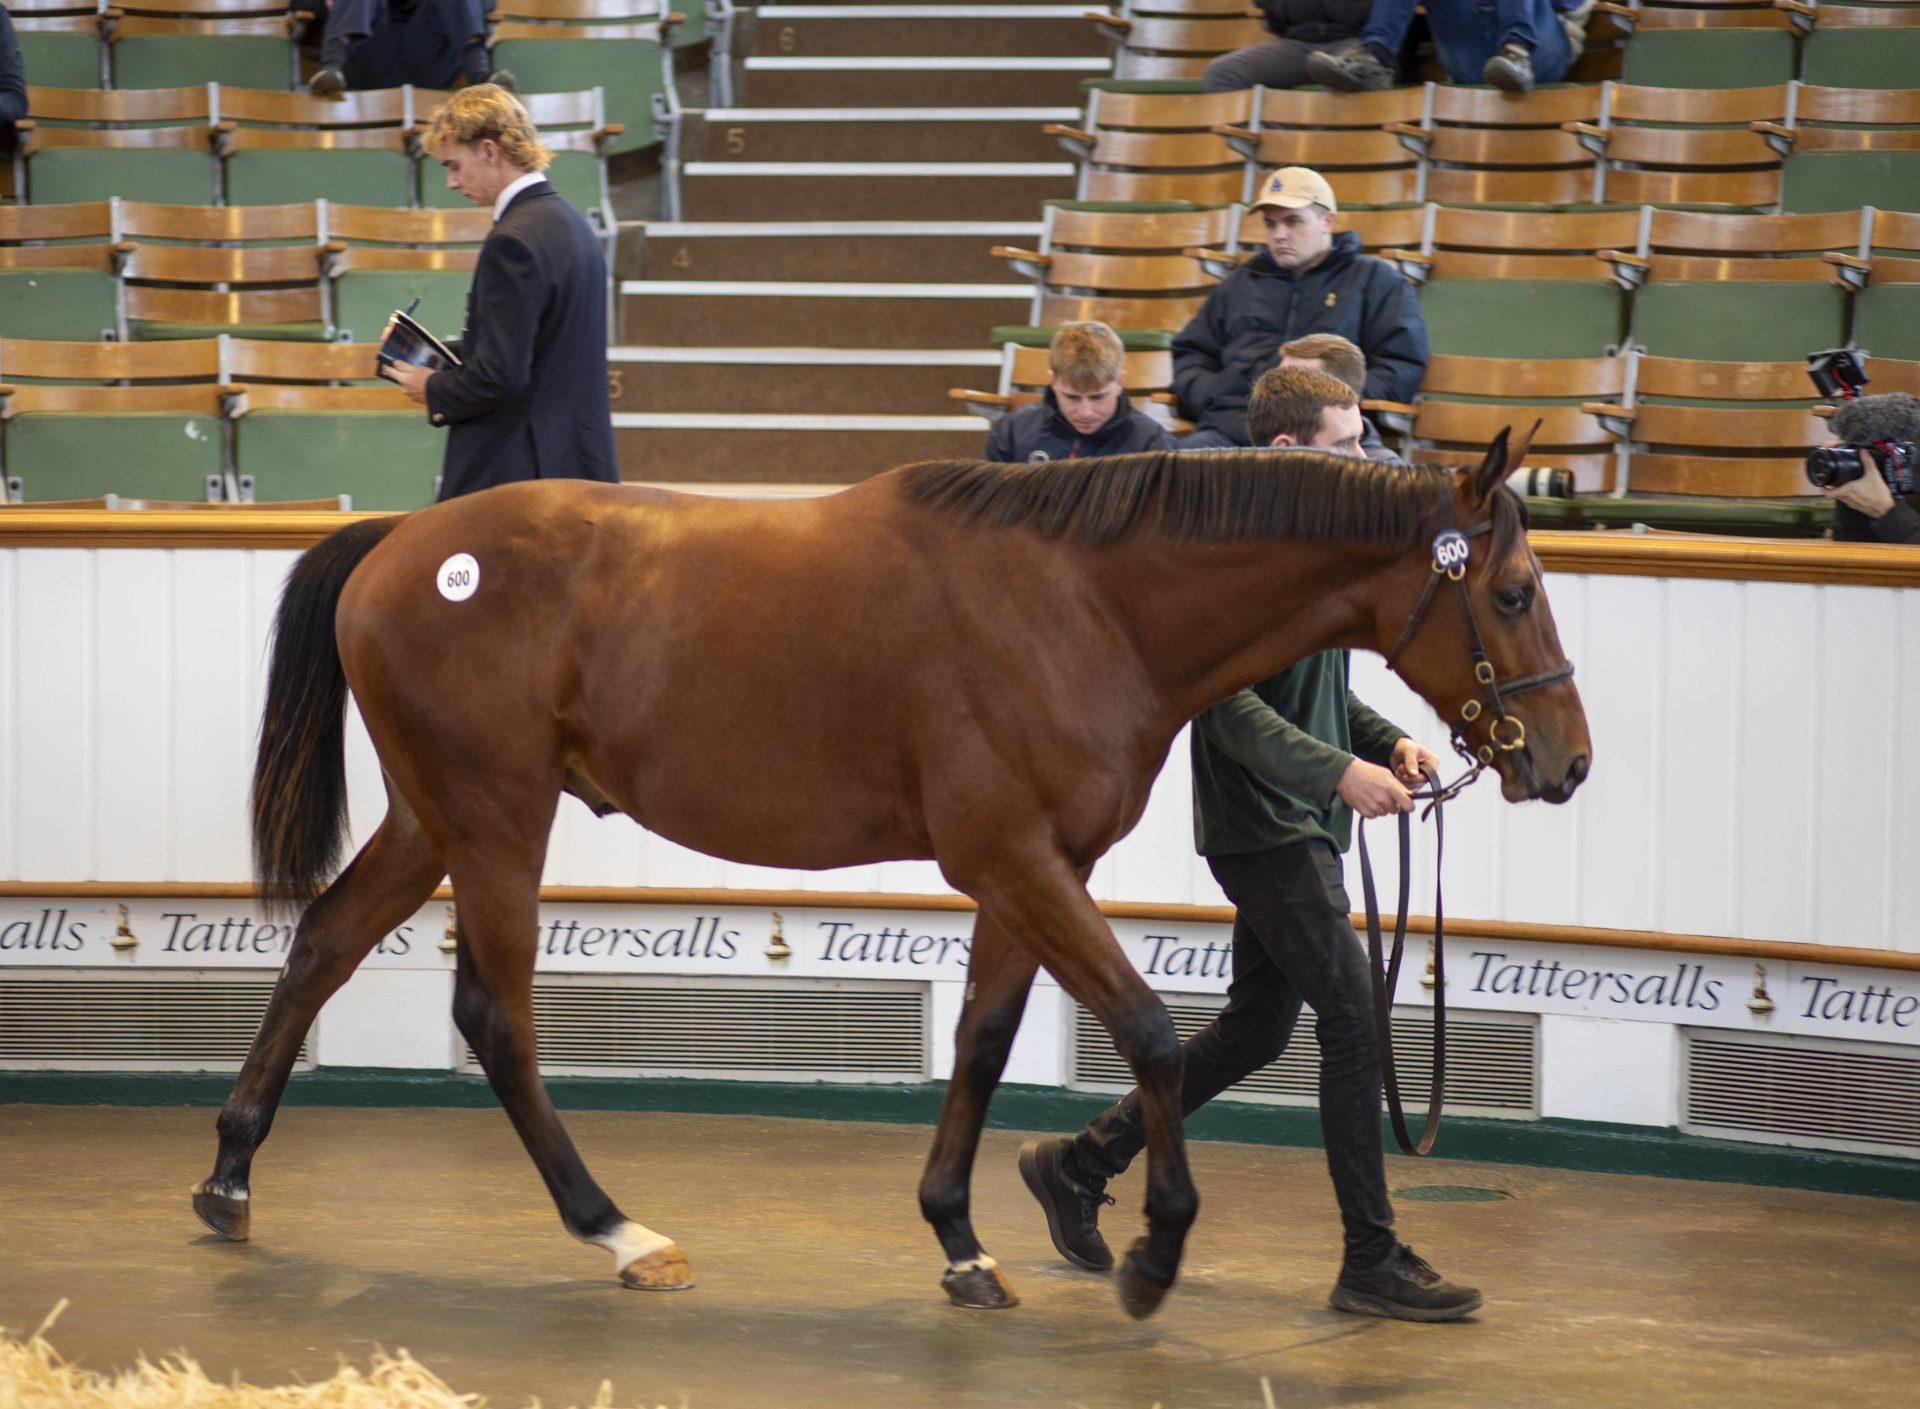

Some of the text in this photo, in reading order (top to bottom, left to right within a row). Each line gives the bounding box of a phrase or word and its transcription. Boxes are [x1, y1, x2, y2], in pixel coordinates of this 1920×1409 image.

[726, 127, 746, 154] 5
[671, 246, 692, 269] 4
[1437, 538, 1469, 566] 600
[447, 569, 470, 588] 600
[538, 916, 740, 960] ttersalls
[1471, 951, 1725, 1011] Tattersalls
[1800, 976, 1919, 1028] Tatte
